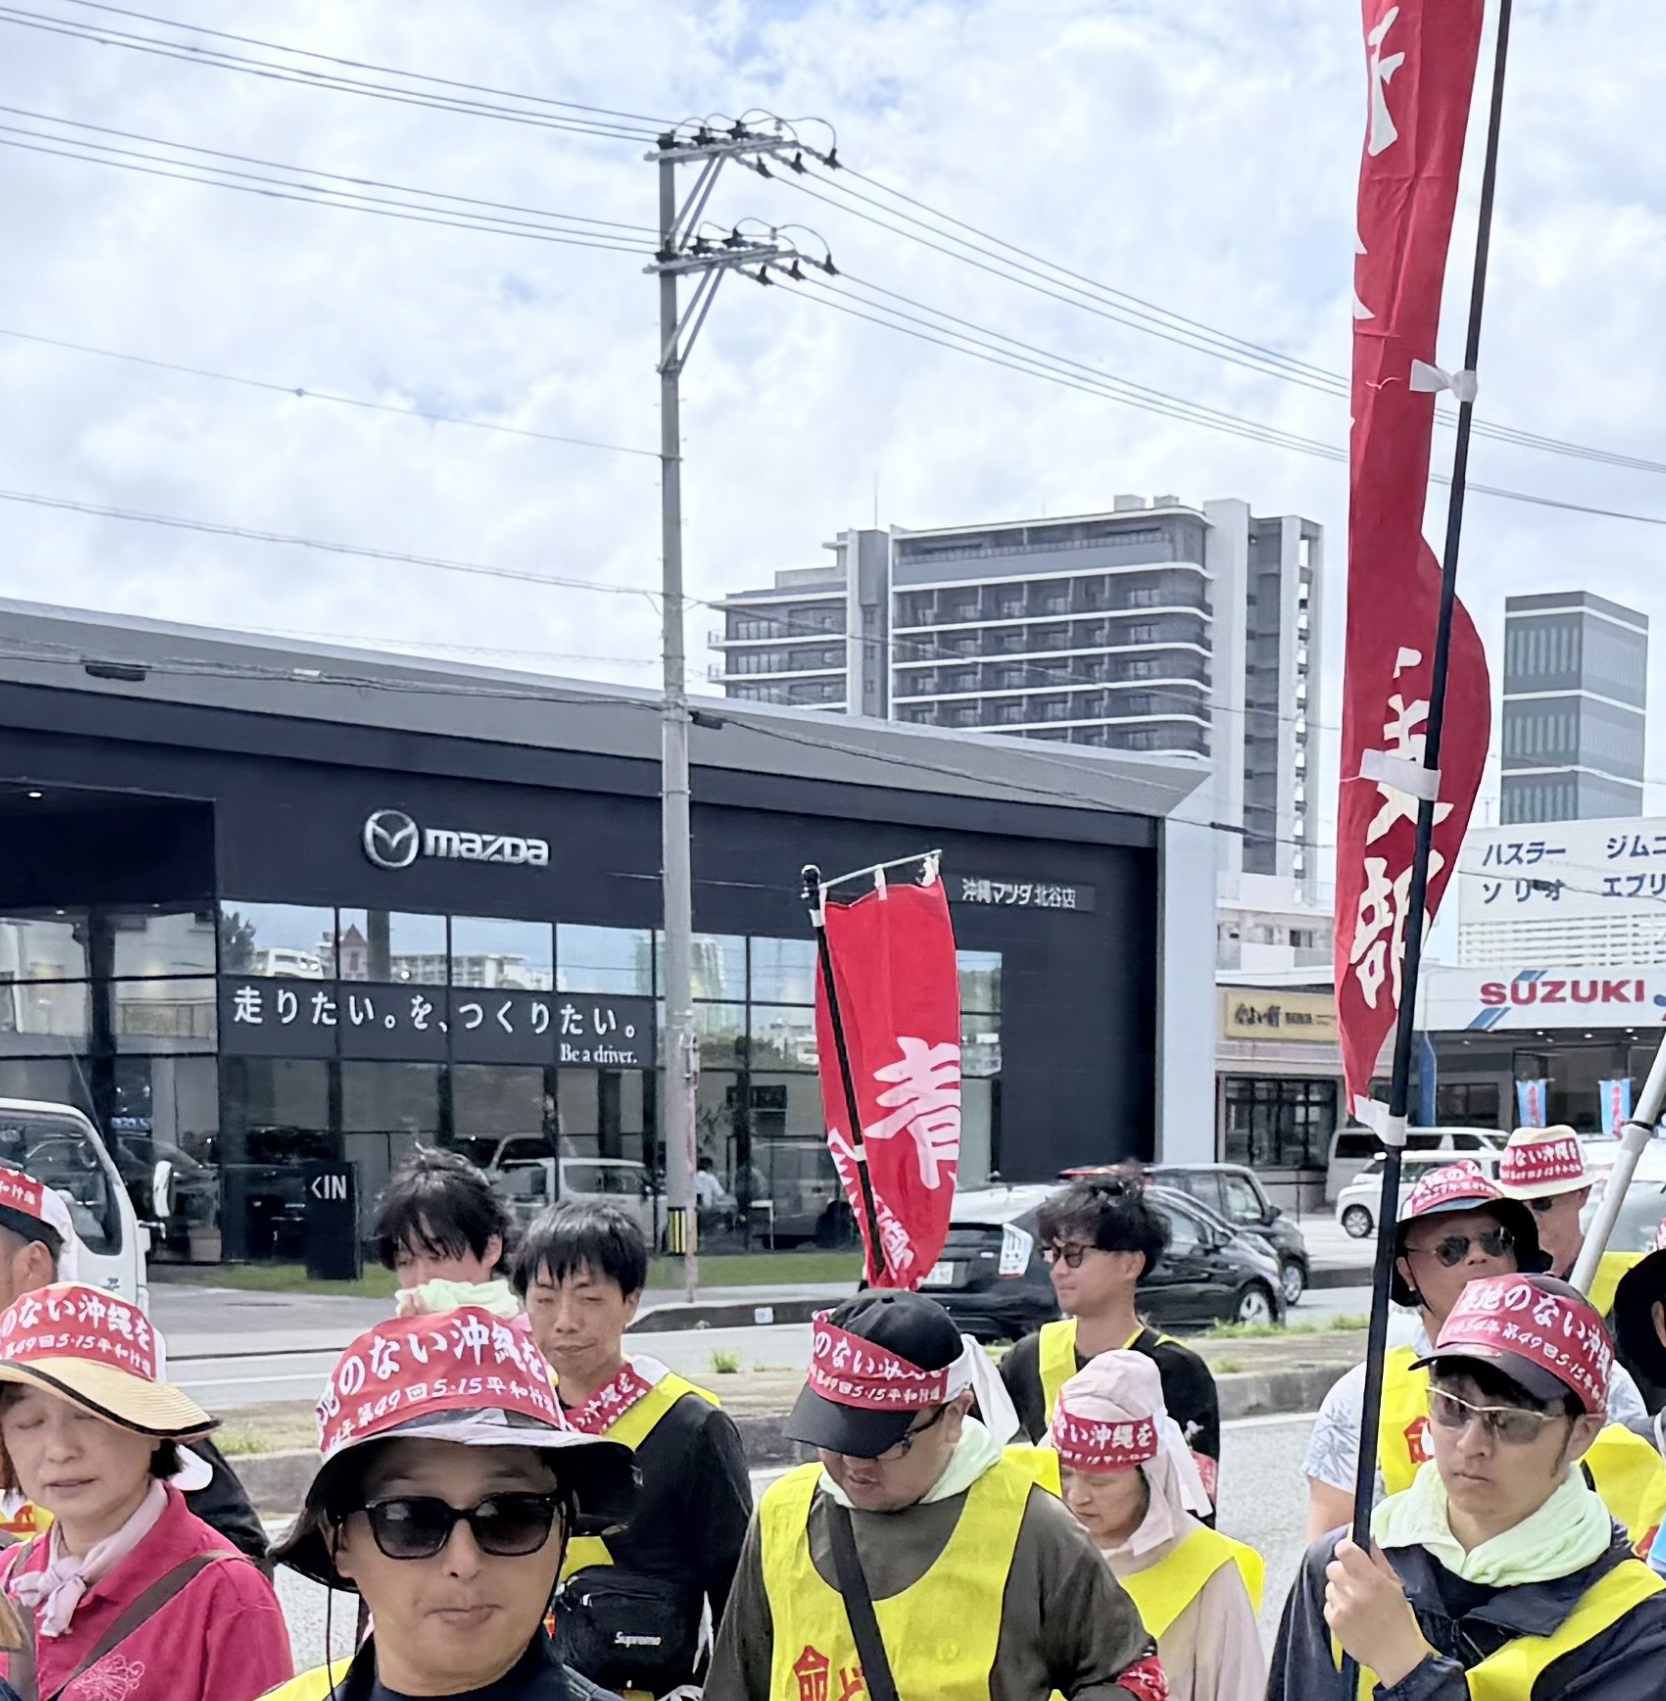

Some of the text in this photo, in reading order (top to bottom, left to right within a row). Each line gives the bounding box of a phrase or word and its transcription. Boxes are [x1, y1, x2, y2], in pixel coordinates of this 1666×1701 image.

[1482, 841, 1567, 867] ハスラー
[1479, 979, 1646, 1007] SUZUKI
[233, 984, 636, 1039] 走りたい。を、つくりたい。
[560, 1043, 638, 1065] Be a driver.
[323, 1174, 348, 1200] IN
